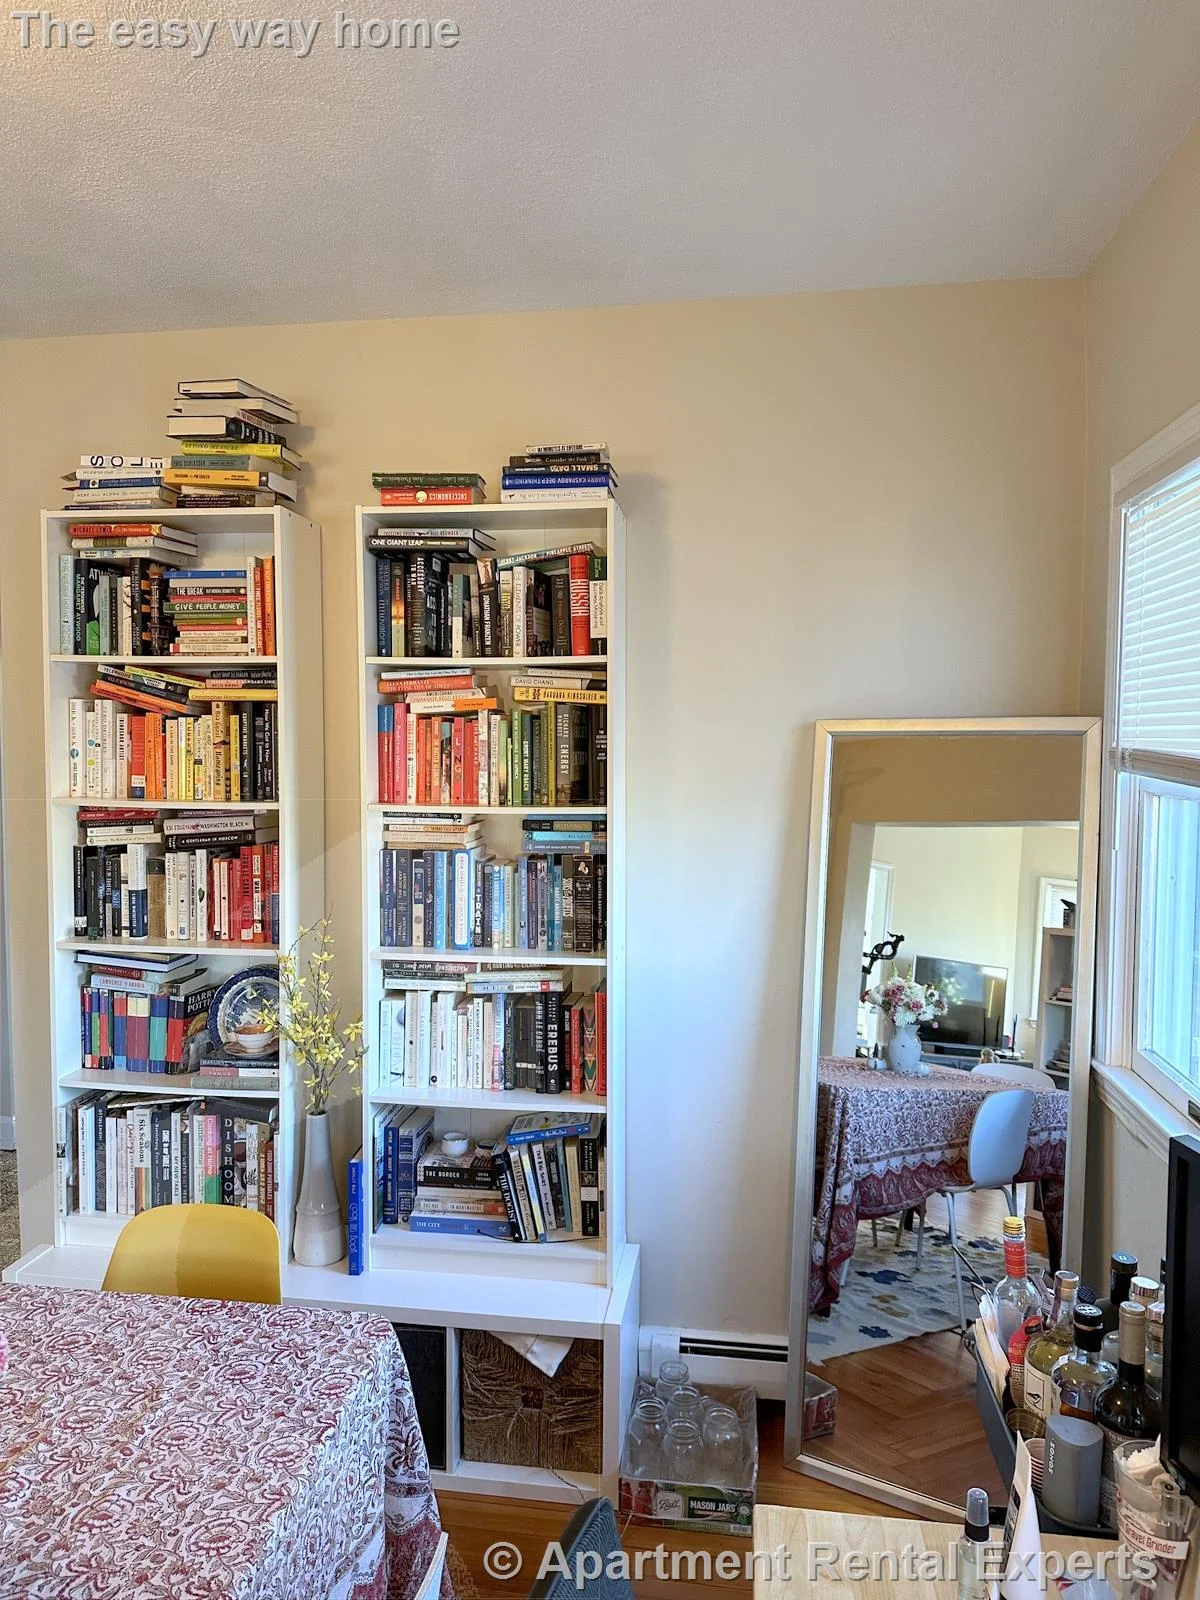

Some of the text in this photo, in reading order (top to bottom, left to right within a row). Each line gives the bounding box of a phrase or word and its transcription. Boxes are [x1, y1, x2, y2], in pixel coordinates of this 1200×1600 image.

[549, 464, 570, 472] DATA
[429, 493, 468, 501] SOCCERNOMICS
[371, 538, 386, 546] ONE
[387, 538, 407, 546] GIANT
[408, 538, 424, 546] LEAP
[416, 557, 425, 592] ACCESSORY
[571, 578, 590, 617] RUSSIA
[482, 594, 490, 620] JONATHAN
[103, 667, 131, 679] TELEPHONE
[543, 691, 597, 701] BARBARA KINGSOLVER
[264, 722, 270, 731] We
[560, 744, 569, 775] ENERGY
[187, 998, 213, 1013] POTTE
[535, 1001, 543, 1020] JOHN
[535, 1031, 545, 1053] CARRÉ
[547, 1024, 558, 1072] EREBUS
[206, 1118, 214, 1146] Cooking
[162, 1155, 170, 1168] TABLE
[173, 1155, 179, 1165] MY
[224, 1117, 233, 1204] DISHOOM
[438, 1170, 460, 1178] BORDER
[498, 1173, 517, 1224] THE DOGIST
[1048, 1441, 1056, 1475] SONOS
[658, 1498, 680, 1511] Ball
[690, 1500, 736, 1513] MASON JARS
[1125, 1522, 1177, 1555] Gravel Grinder
